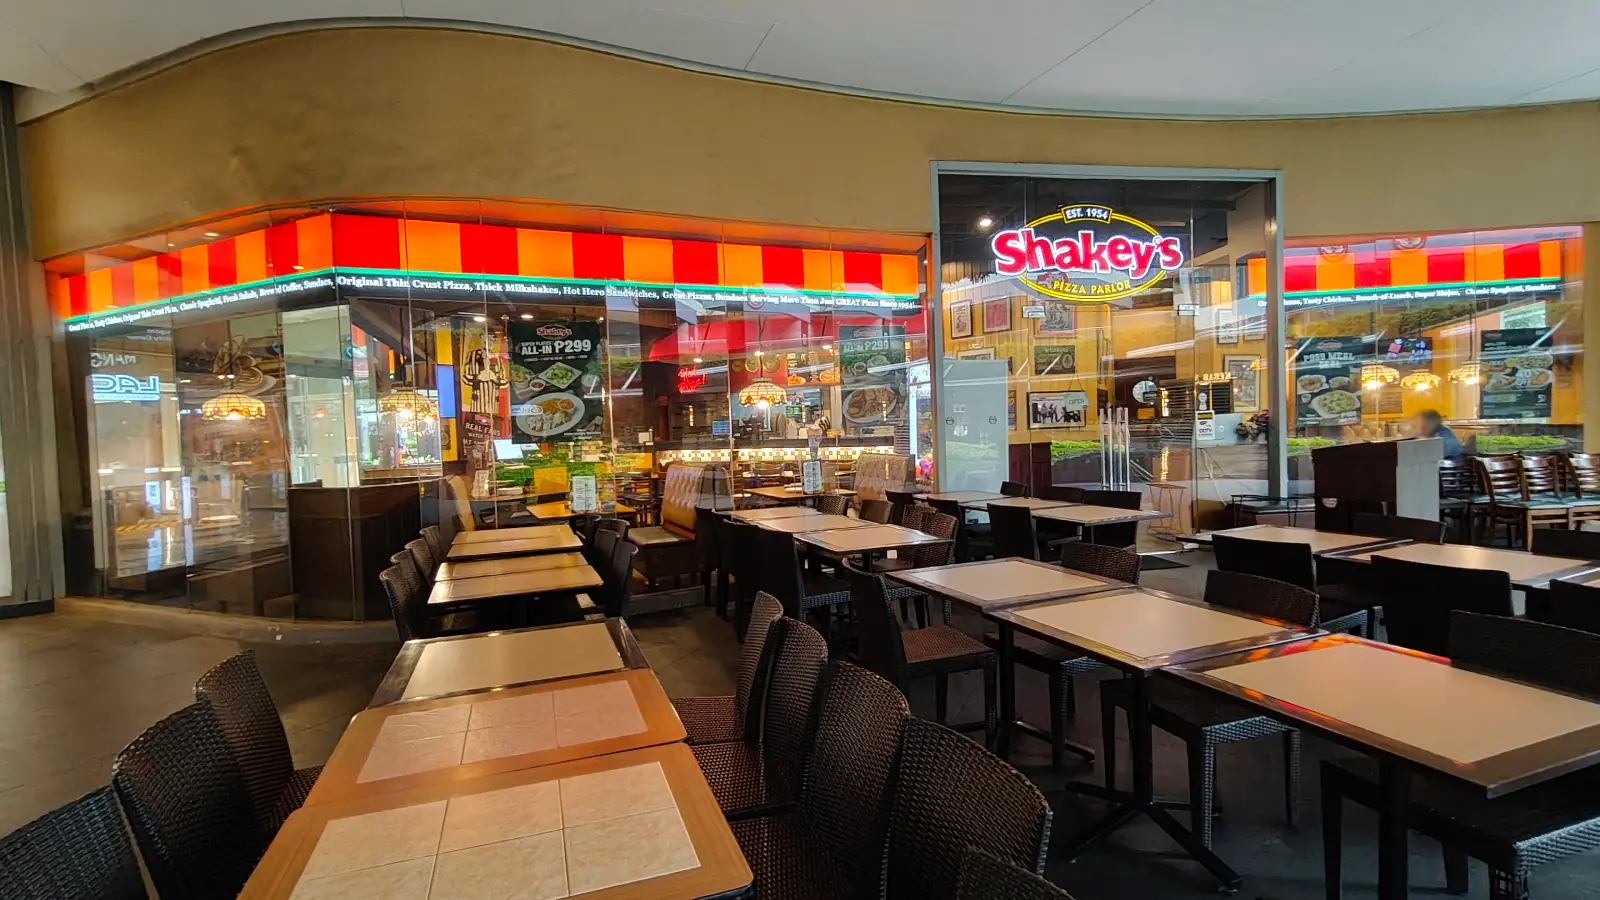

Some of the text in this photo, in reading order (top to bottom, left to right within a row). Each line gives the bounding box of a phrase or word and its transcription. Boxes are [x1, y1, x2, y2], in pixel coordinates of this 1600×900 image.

[1065, 208, 1109, 220] EST. 1954
[991, 227, 1184, 280] Shakey's
[223, 294, 238, 303] Fresh
[282, 283, 304, 293] Coffee,
[303, 278, 334, 290] Sundaes,
[338, 276, 383, 288] Original
[385, 278, 410, 288] Thin
[412, 280, 442, 289] Crust
[443, 281, 473, 292] Pizza,
[474, 282, 503, 292] Thick
[505, 284, 561, 295] Milkshakes,
[563, 286, 581, 295] Hot
[582, 287, 605, 296] Hero
[606, 288, 660, 300] Sandwiches,
[662, 291, 686, 299] Great
[750, 295, 780, 304] Serving
[780, 295, 800, 303] More
[800, 296, 819, 304] Than
[835, 298, 860, 306] GREAT
[1053, 280, 1132, 295] PIZZA PARLOR
[521, 345, 553, 356] ALL-IN
[465, 422, 483, 432] REAL
